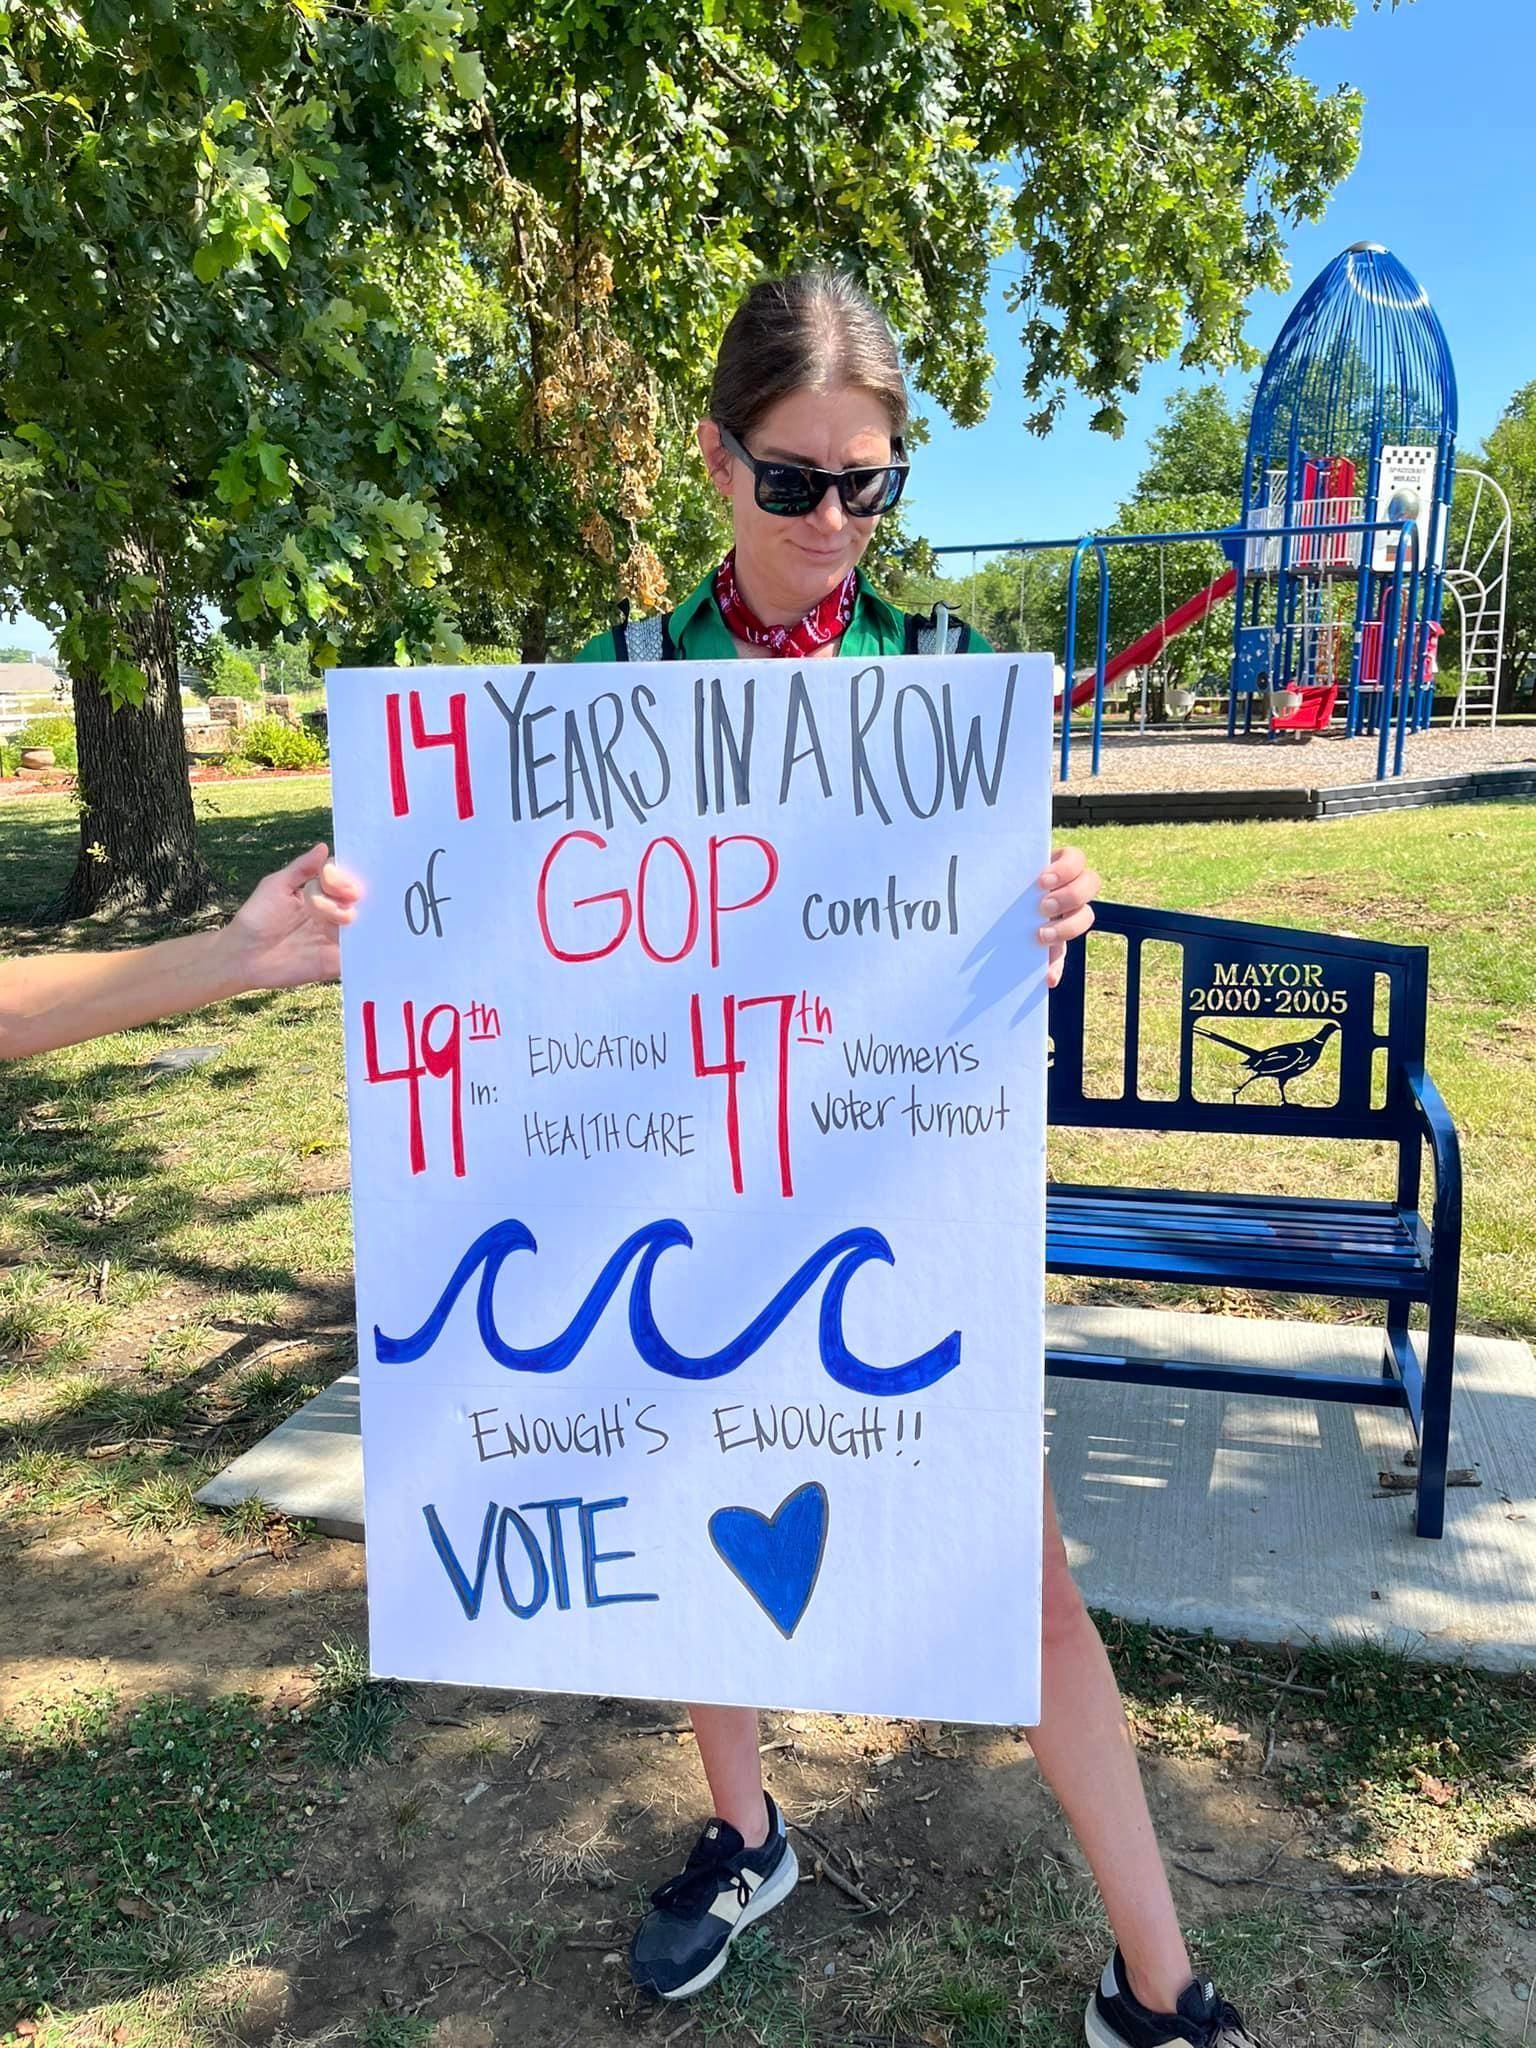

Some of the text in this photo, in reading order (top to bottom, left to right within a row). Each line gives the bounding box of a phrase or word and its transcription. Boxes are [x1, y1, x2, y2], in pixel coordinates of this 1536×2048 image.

[385, 664, 1019, 830] 14 YEARS IN A ROW
[404, 830, 959, 969] of GOP control
[1189, 988, 1349, 1014] 2000-2005
[1212, 963, 1325, 988] MAYOR
[528, 1031, 667, 1077] EDUCATION
[843, 1033, 980, 1079] Women's
[810, 1084, 1011, 1138] voter turnout
[468, 1398, 923, 1468] ENOUGH'S ENOUGH!!
[422, 1495, 660, 1621] VOTE
